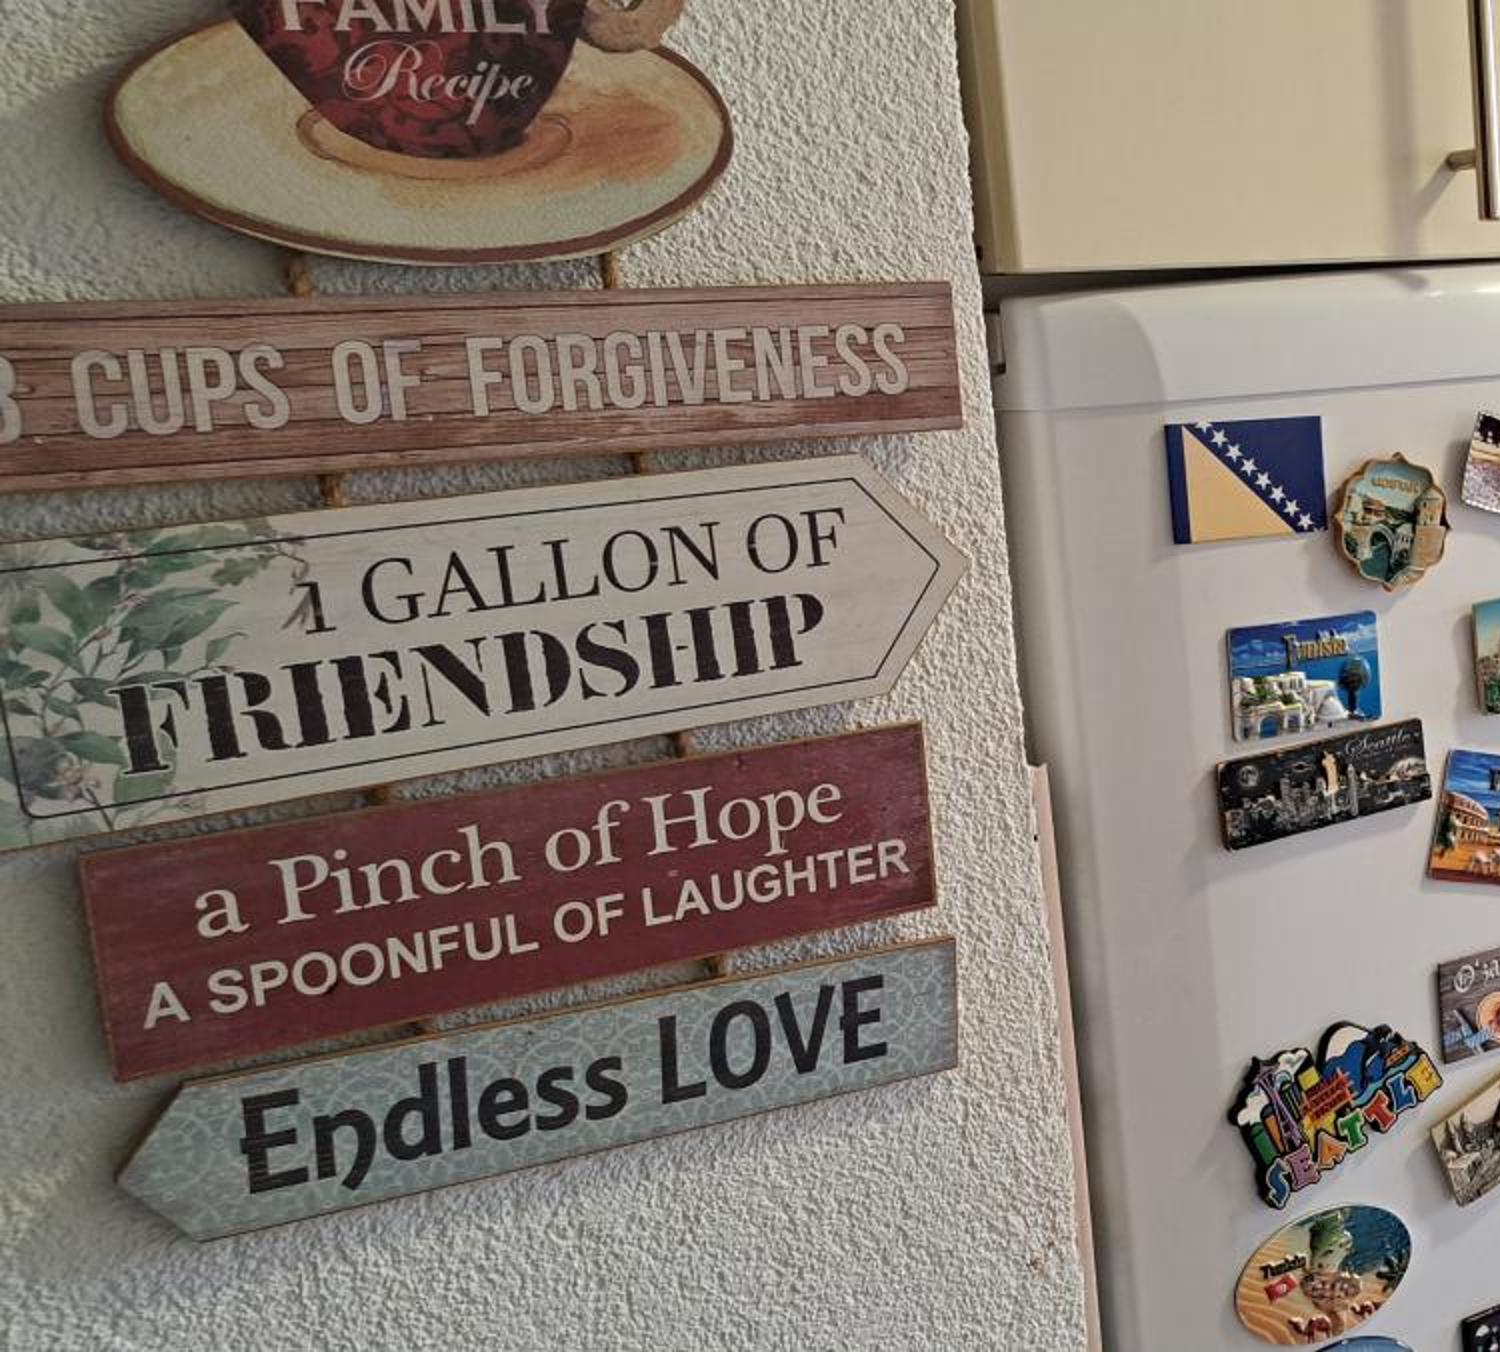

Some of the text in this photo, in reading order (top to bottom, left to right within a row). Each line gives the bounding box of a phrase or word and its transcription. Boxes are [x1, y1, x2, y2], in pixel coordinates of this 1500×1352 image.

[281, 0, 559, 33] FAMILY
[343, 40, 537, 126] Recipe
[71, 344, 291, 440] CUPS
[331, 338, 423, 426] OF
[466, 323, 911, 417] FORGIVENESS
[295, 507, 846, 636] 1 GALLON OF
[110, 592, 825, 775] FRIENDSHIP
[143, 838, 911, 1029] A SPOONFUL OF LAUGHTER
[194, 782, 844, 939] a Pinch of Hope
[240, 974, 888, 1194] Endless LOVE
[1266, 1053, 1441, 1208] SEATTLE
